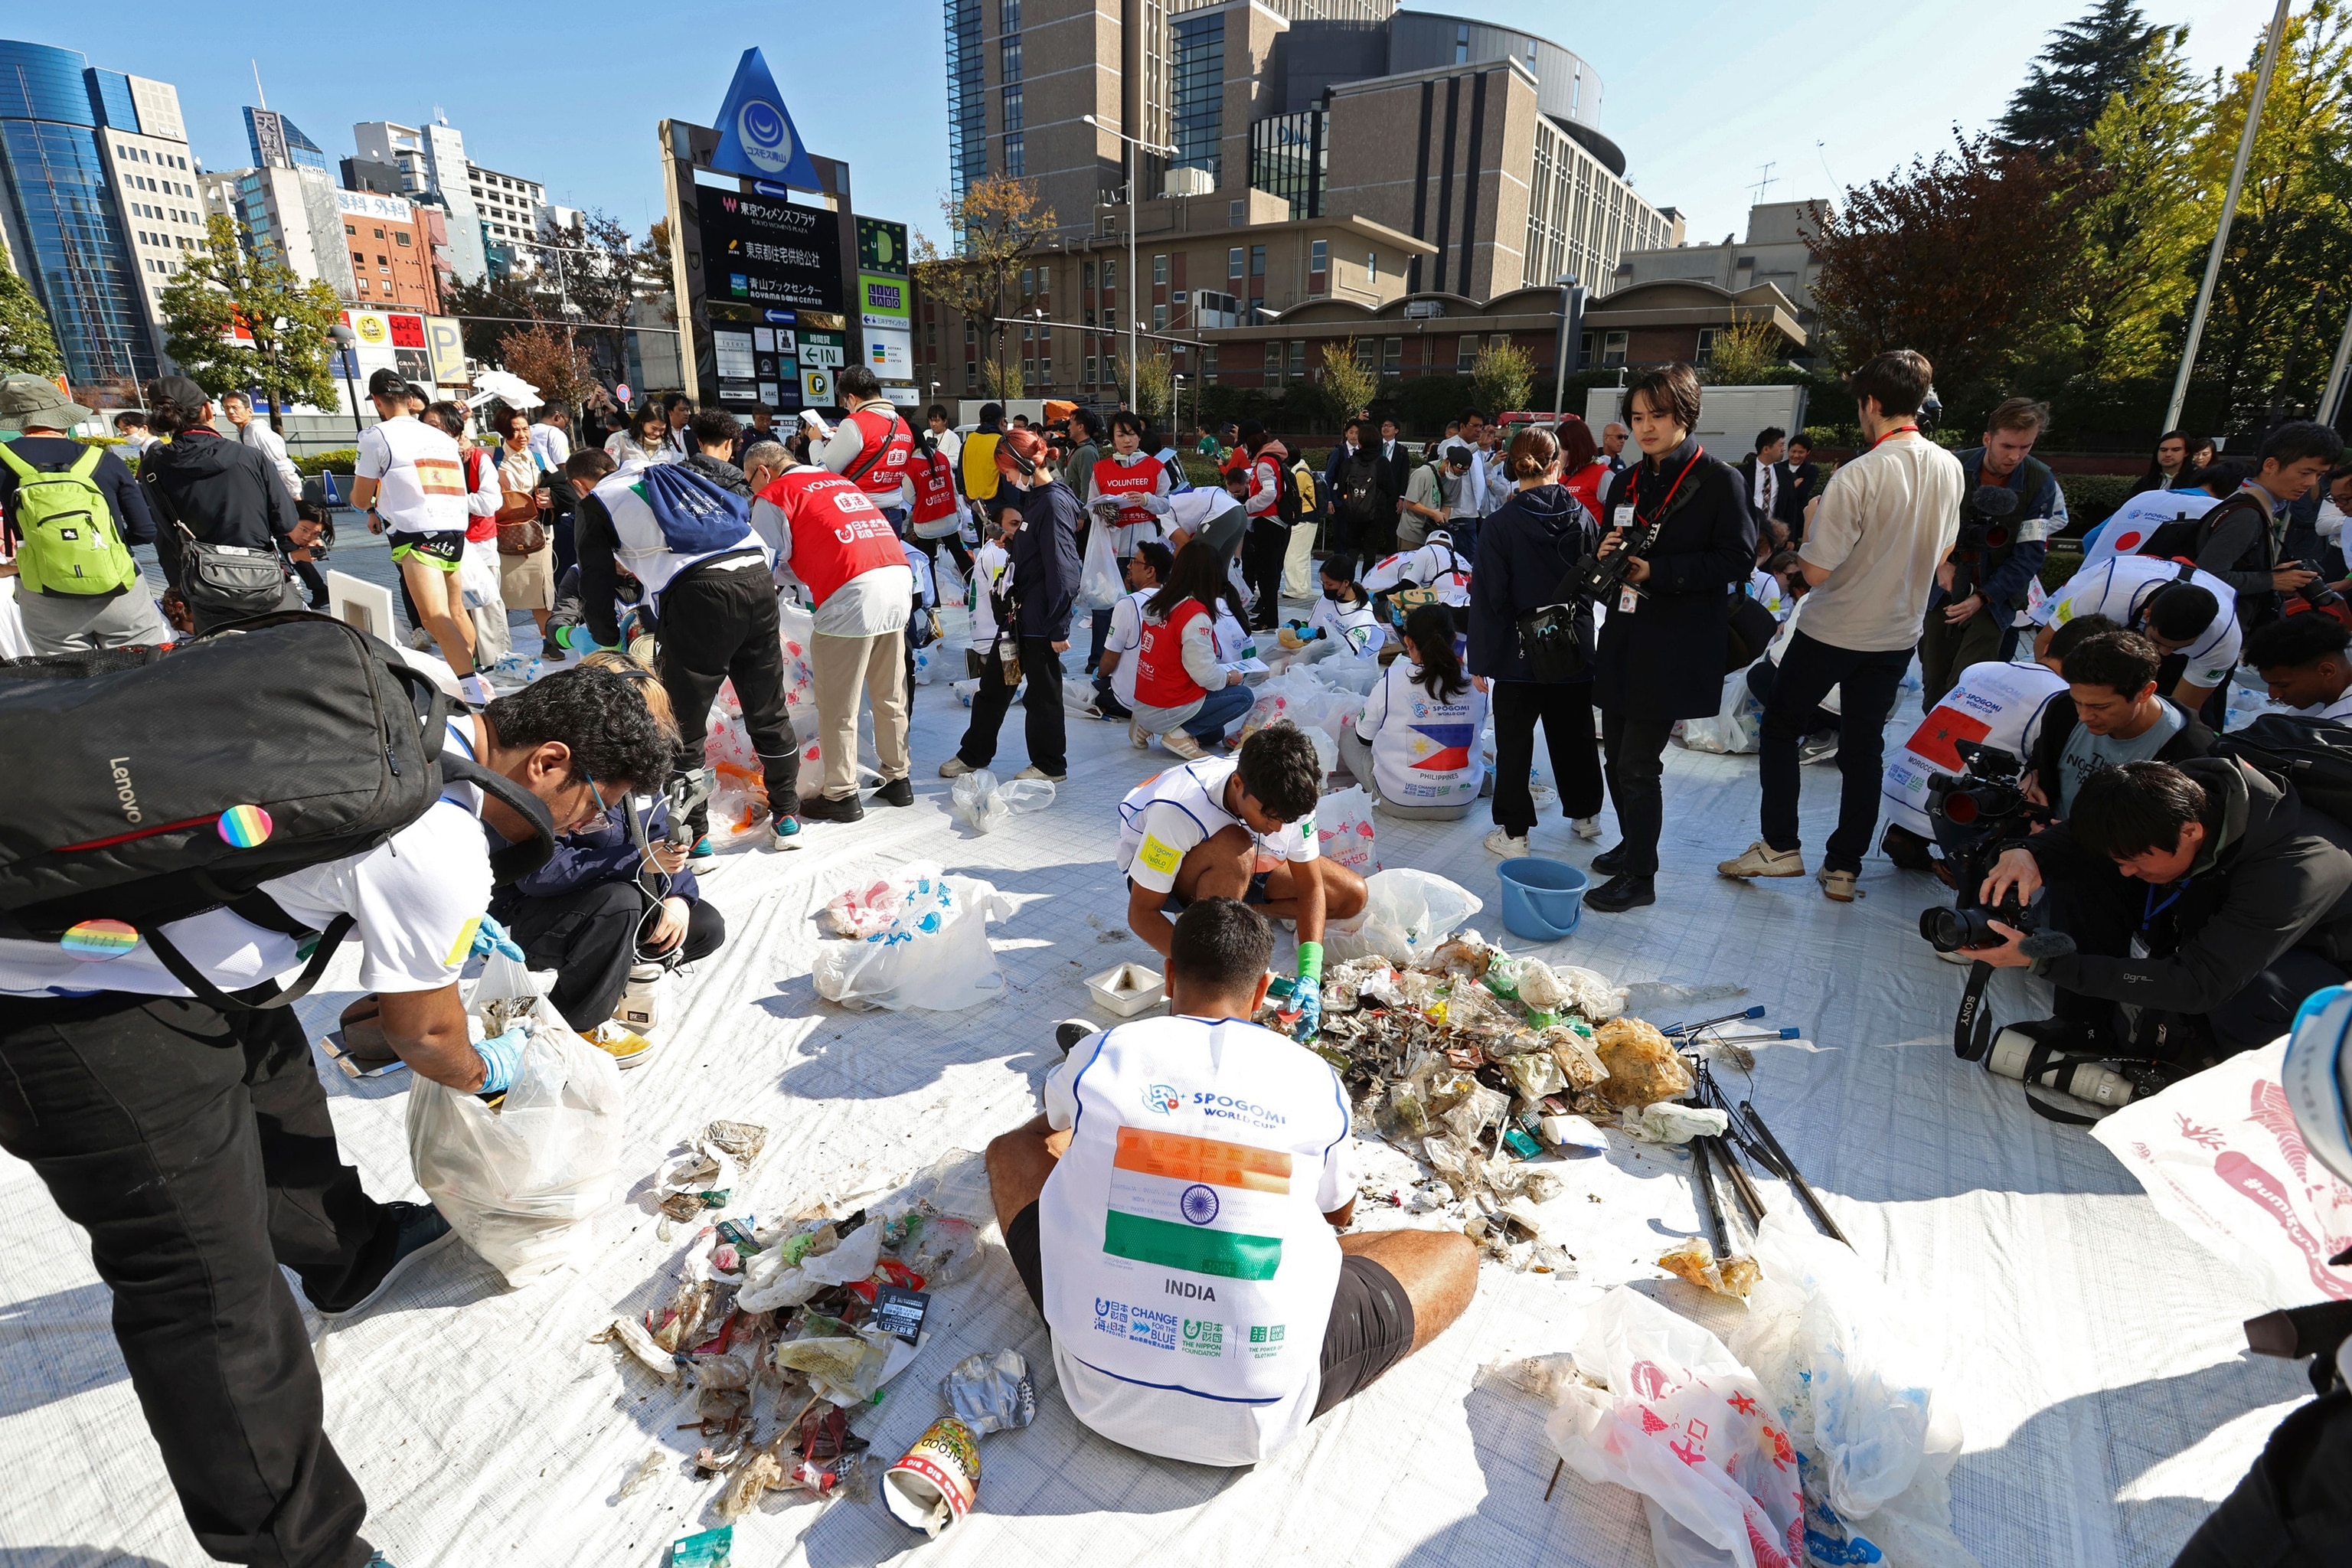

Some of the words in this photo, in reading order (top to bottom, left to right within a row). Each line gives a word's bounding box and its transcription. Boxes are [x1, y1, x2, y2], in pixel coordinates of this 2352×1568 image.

[746, 145, 786, 163] コスモス青山
[374, 199, 407, 217] 外科
[740, 201, 816, 227] 東京ウィメンズプラザ
[769, 222, 792, 231] WOMEN'S
[745, 241, 820, 268] 東京都住宅供給公社
[749, 277, 822, 296] 青山ブックセンター
[870, 285, 899, 296] LIVE
[750, 291, 780, 301] AOYAMA
[781, 293, 799, 302] BOOK
[799, 296, 822, 305] CENTER
[432, 325, 457, 362] P
[809, 334, 831, 345] 時間貸
[821, 349, 836, 364] IN
[1107, 478, 1148, 487] VOLUNTEER
[1966, 693, 2003, 713] SPOGOMI
[1966, 701, 1983, 711] WORLD
[1907, 756, 1937, 774] MOROCCO
[1419, 773, 1459, 781] PHILIPPINES
[110, 756, 142, 824] Lenovo
[2123, 973, 2153, 983] Ogre
[1960, 995, 1975, 1026] SONY
[1193, 1093, 1286, 1124] SPOGOMI
[1204, 1108, 1250, 1123] WORLD
[1253, 1120, 1276, 1129] CUP
[1165, 1279, 1217, 1302] INDIA
[1131, 1307, 1178, 1326] CHANGE
[1094, 1317, 1127, 1333] 海と日本
[1152, 1322, 1165, 1331] FOR
[1165, 1325, 1178, 1334] THE
[1203, 1321, 1223, 1332] 日本
[1106, 1329, 1126, 1338] PROJECT
[1151, 1329, 1176, 1345] BLUE
[1181, 1348, 1221, 1357] FOUNDATION
[1196, 1342, 1221, 1351] NIPPON
[906, 1459, 924, 1469] BIG
[921, 1438, 969, 1477] SEAFOOD
[926, 1466, 943, 1481] BIG
[944, 1481, 956, 1498] BIG
